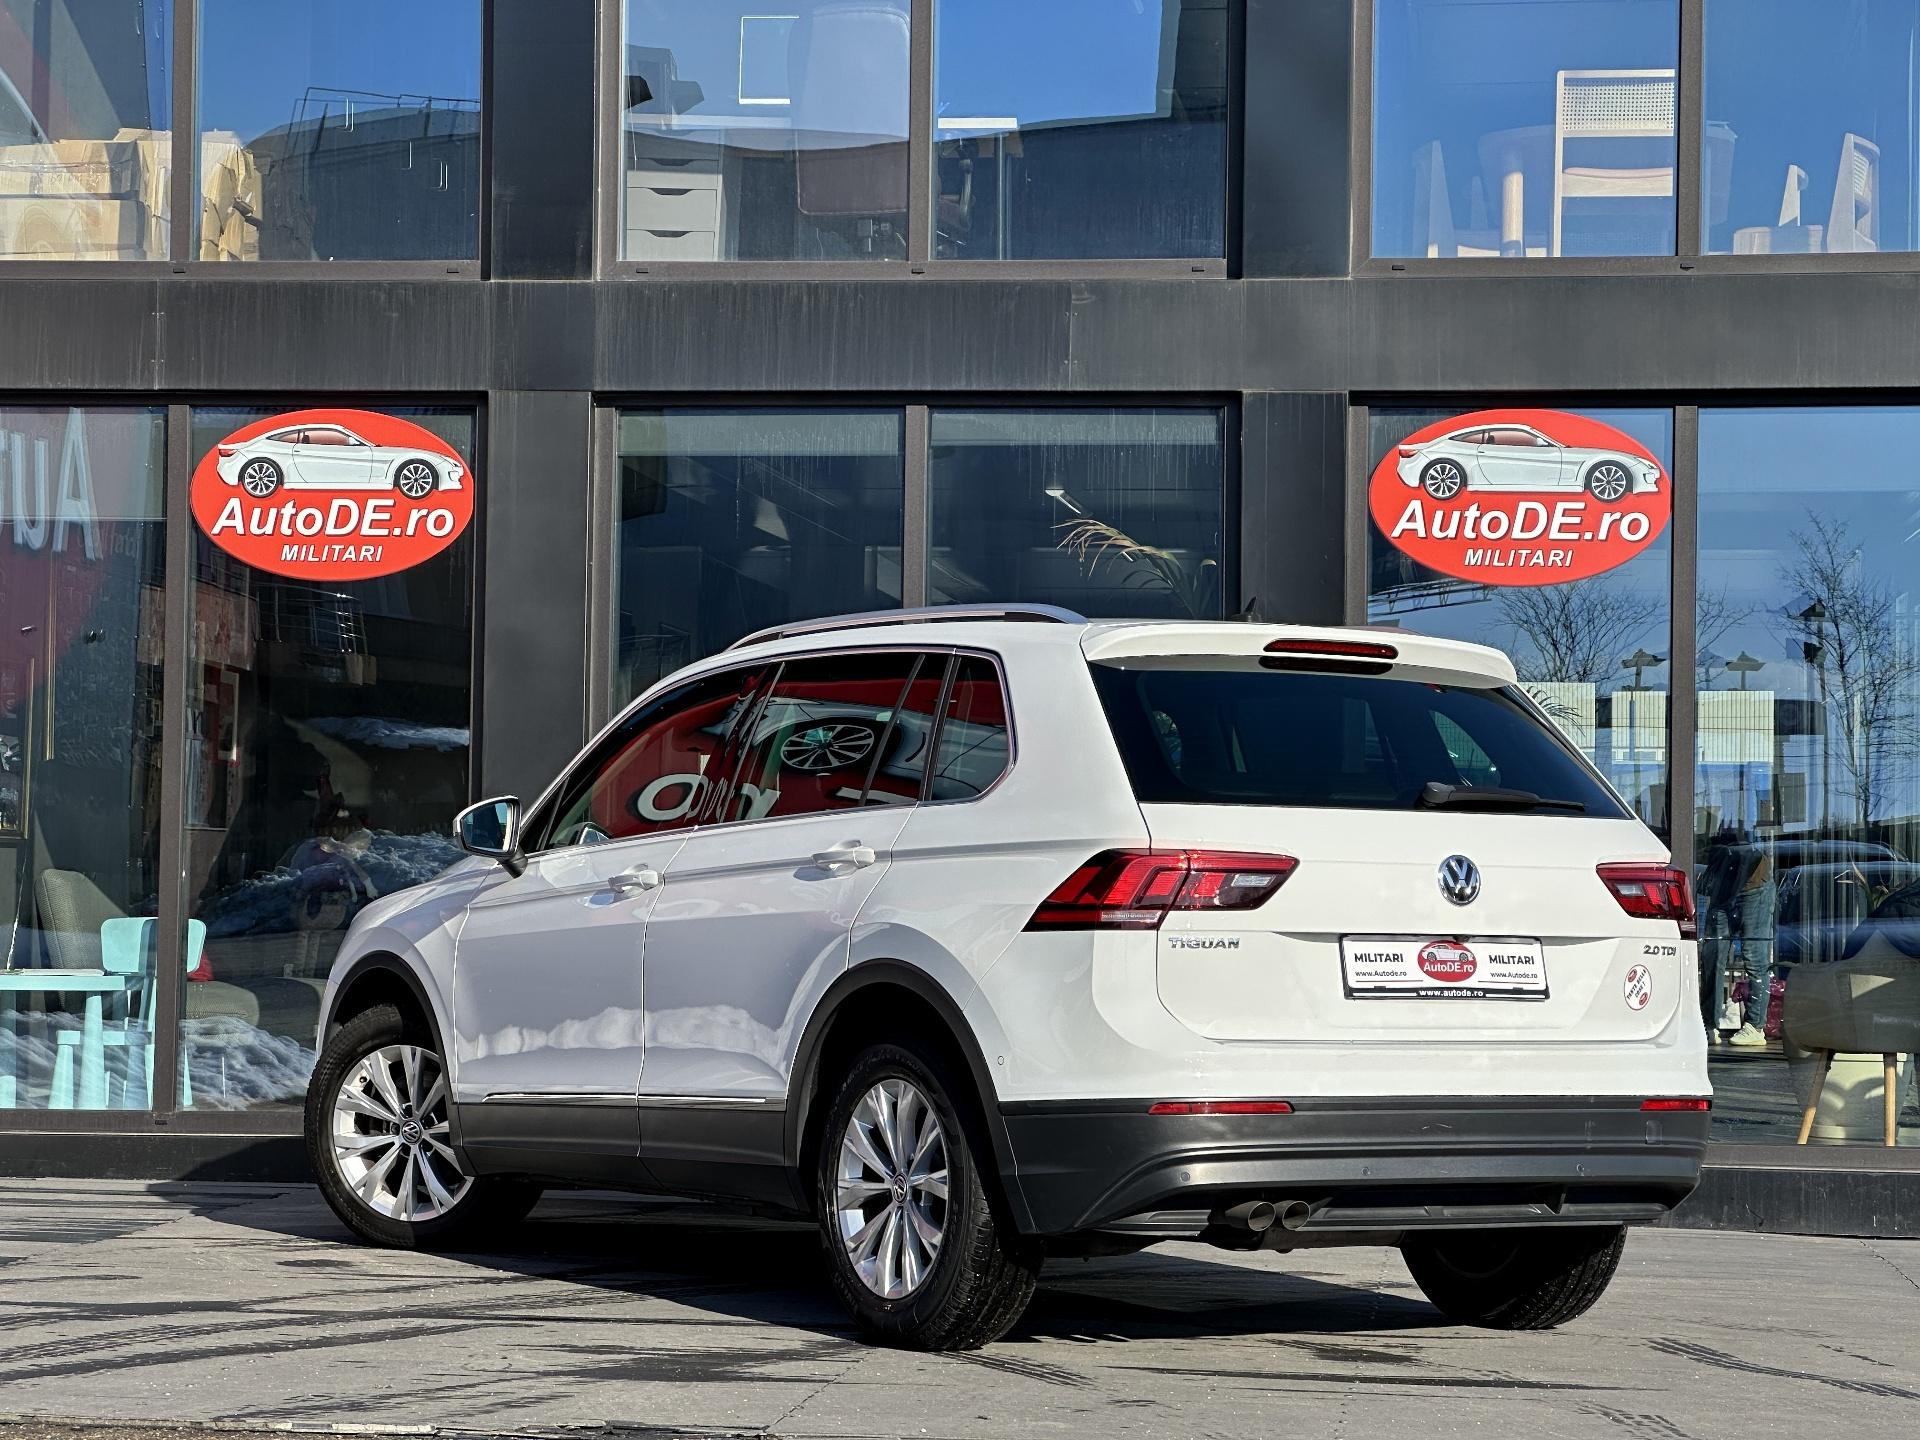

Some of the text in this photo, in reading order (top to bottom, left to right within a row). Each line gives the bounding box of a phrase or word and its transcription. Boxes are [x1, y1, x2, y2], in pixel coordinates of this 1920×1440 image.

[211, 497, 454, 537] AutoDE.ro
[1390, 499, 1650, 541] AutoDE.ro
[281, 544, 382, 562] MILITARI
[1464, 548, 1573, 567] MILITARI
[1168, 937, 1240, 949] TIGUAN
[1643, 944, 1677, 956] 2.0 TDI
[1354, 952, 1404, 963] MILITARI
[1488, 954, 1535, 965] MILITARI
[1423, 961, 1474, 973] AutoDE.ro
[1418, 989, 1484, 997] www.autode.ro
